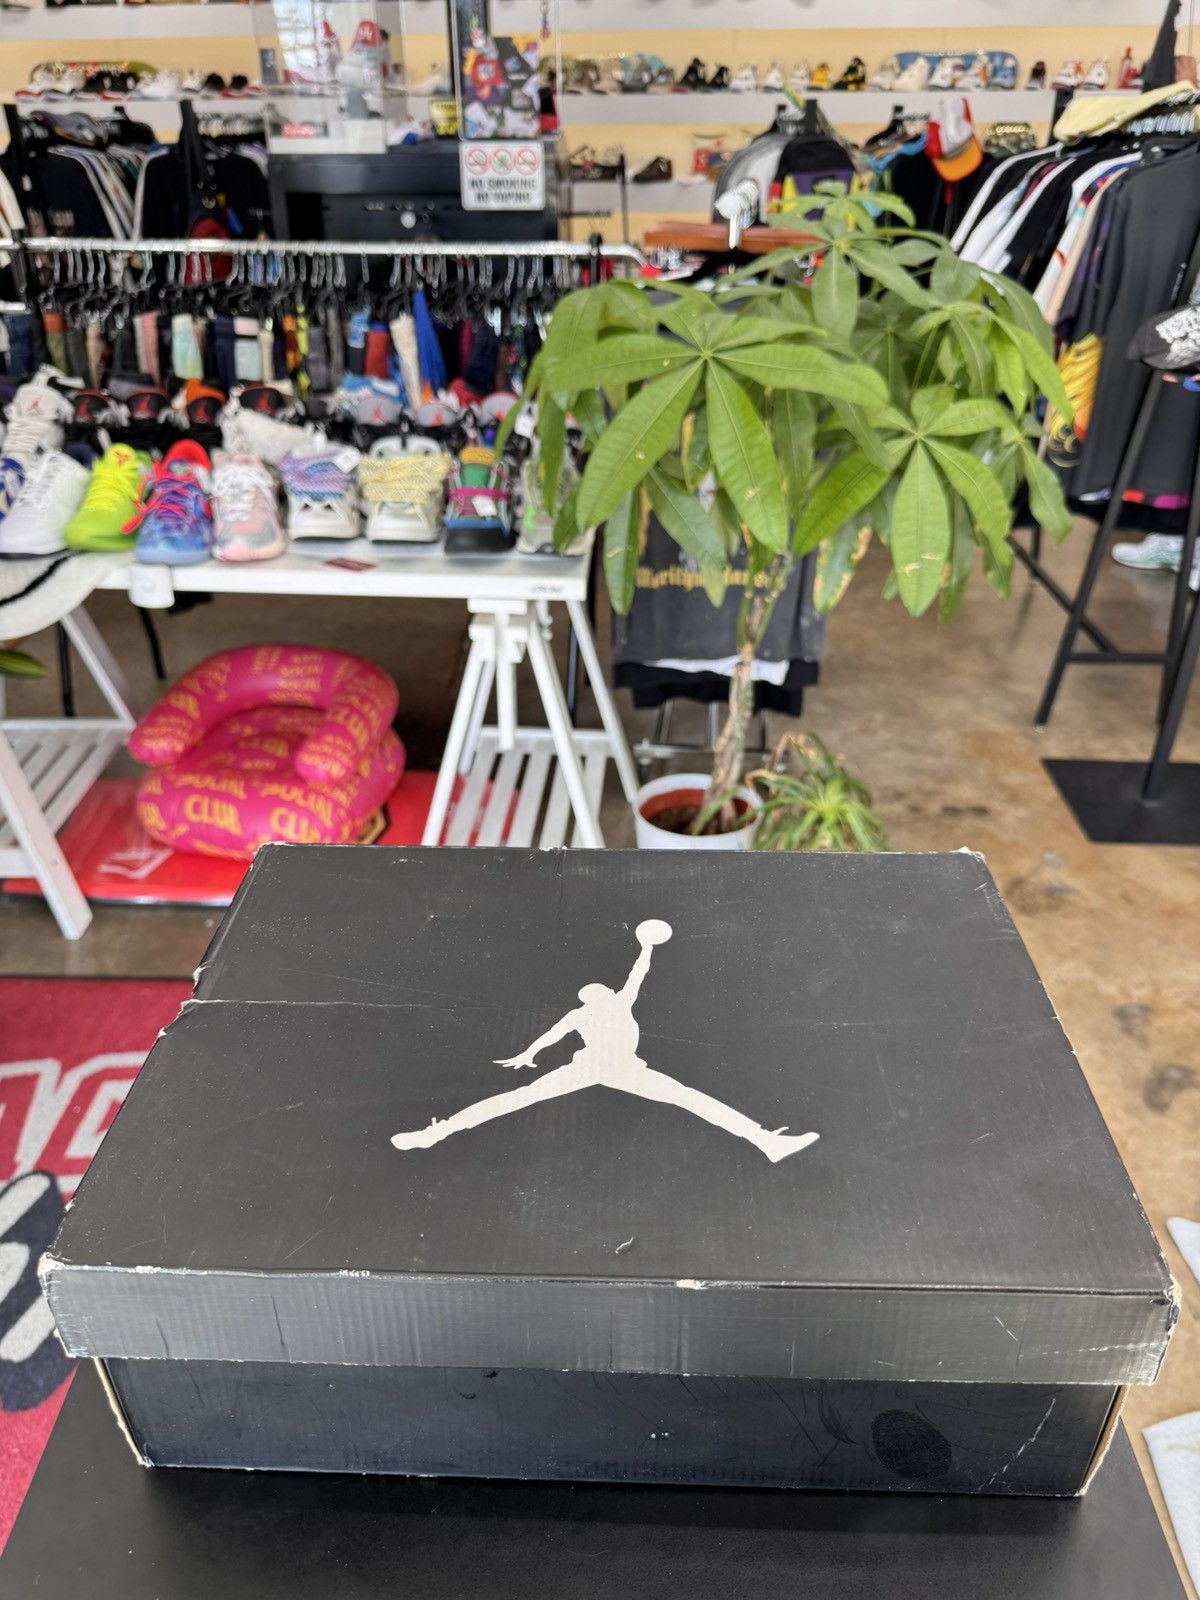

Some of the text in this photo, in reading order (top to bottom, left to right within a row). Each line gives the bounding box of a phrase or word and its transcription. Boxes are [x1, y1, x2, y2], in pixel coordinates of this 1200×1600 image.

[471, 178, 536, 190] NO SMOKING
[476, 192, 531, 203] NO VAPING
